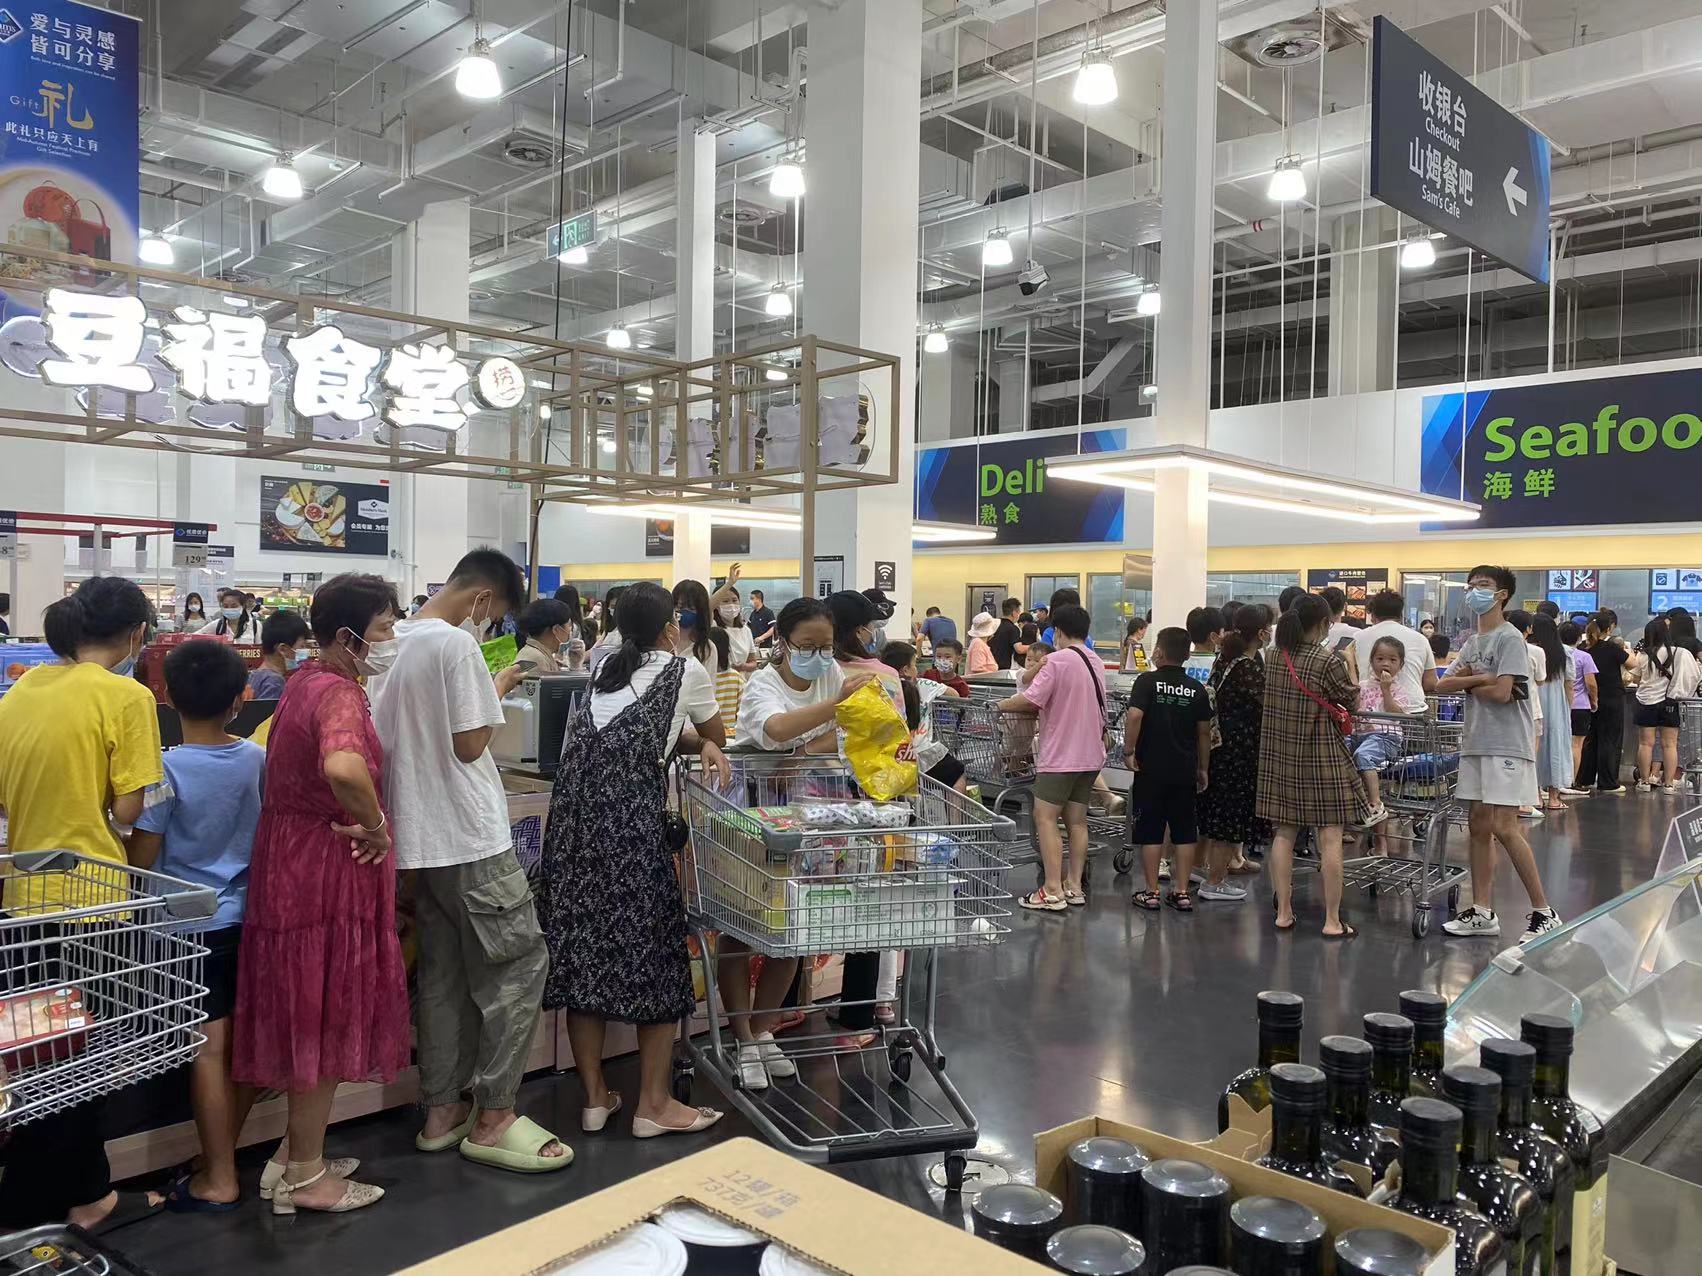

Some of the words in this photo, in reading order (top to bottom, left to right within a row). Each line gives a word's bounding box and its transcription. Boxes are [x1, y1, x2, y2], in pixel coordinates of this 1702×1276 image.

[30, 12, 116, 51] 爱与灵感
[30, 34, 116, 71] 皆可分享
[9, 95, 39, 110] Gift
[32, 79, 94, 130] 礼
[1418, 70, 1467, 138] 收银台
[1425, 117, 1461, 152] Checkout
[1409, 136, 1474, 207] 山姆餐吧
[1421, 184, 1443, 210] Sam's
[1443, 197, 1461, 219] Cafe
[38, 287, 469, 432] 豆福食堂
[980, 458, 1045, 497] Deli
[1482, 468, 1556, 500] 海鲜
[980, 501, 1021, 525] 熟食
[1657, 595, 1668, 611] 2
[1155, 681, 1197, 698] Finder
